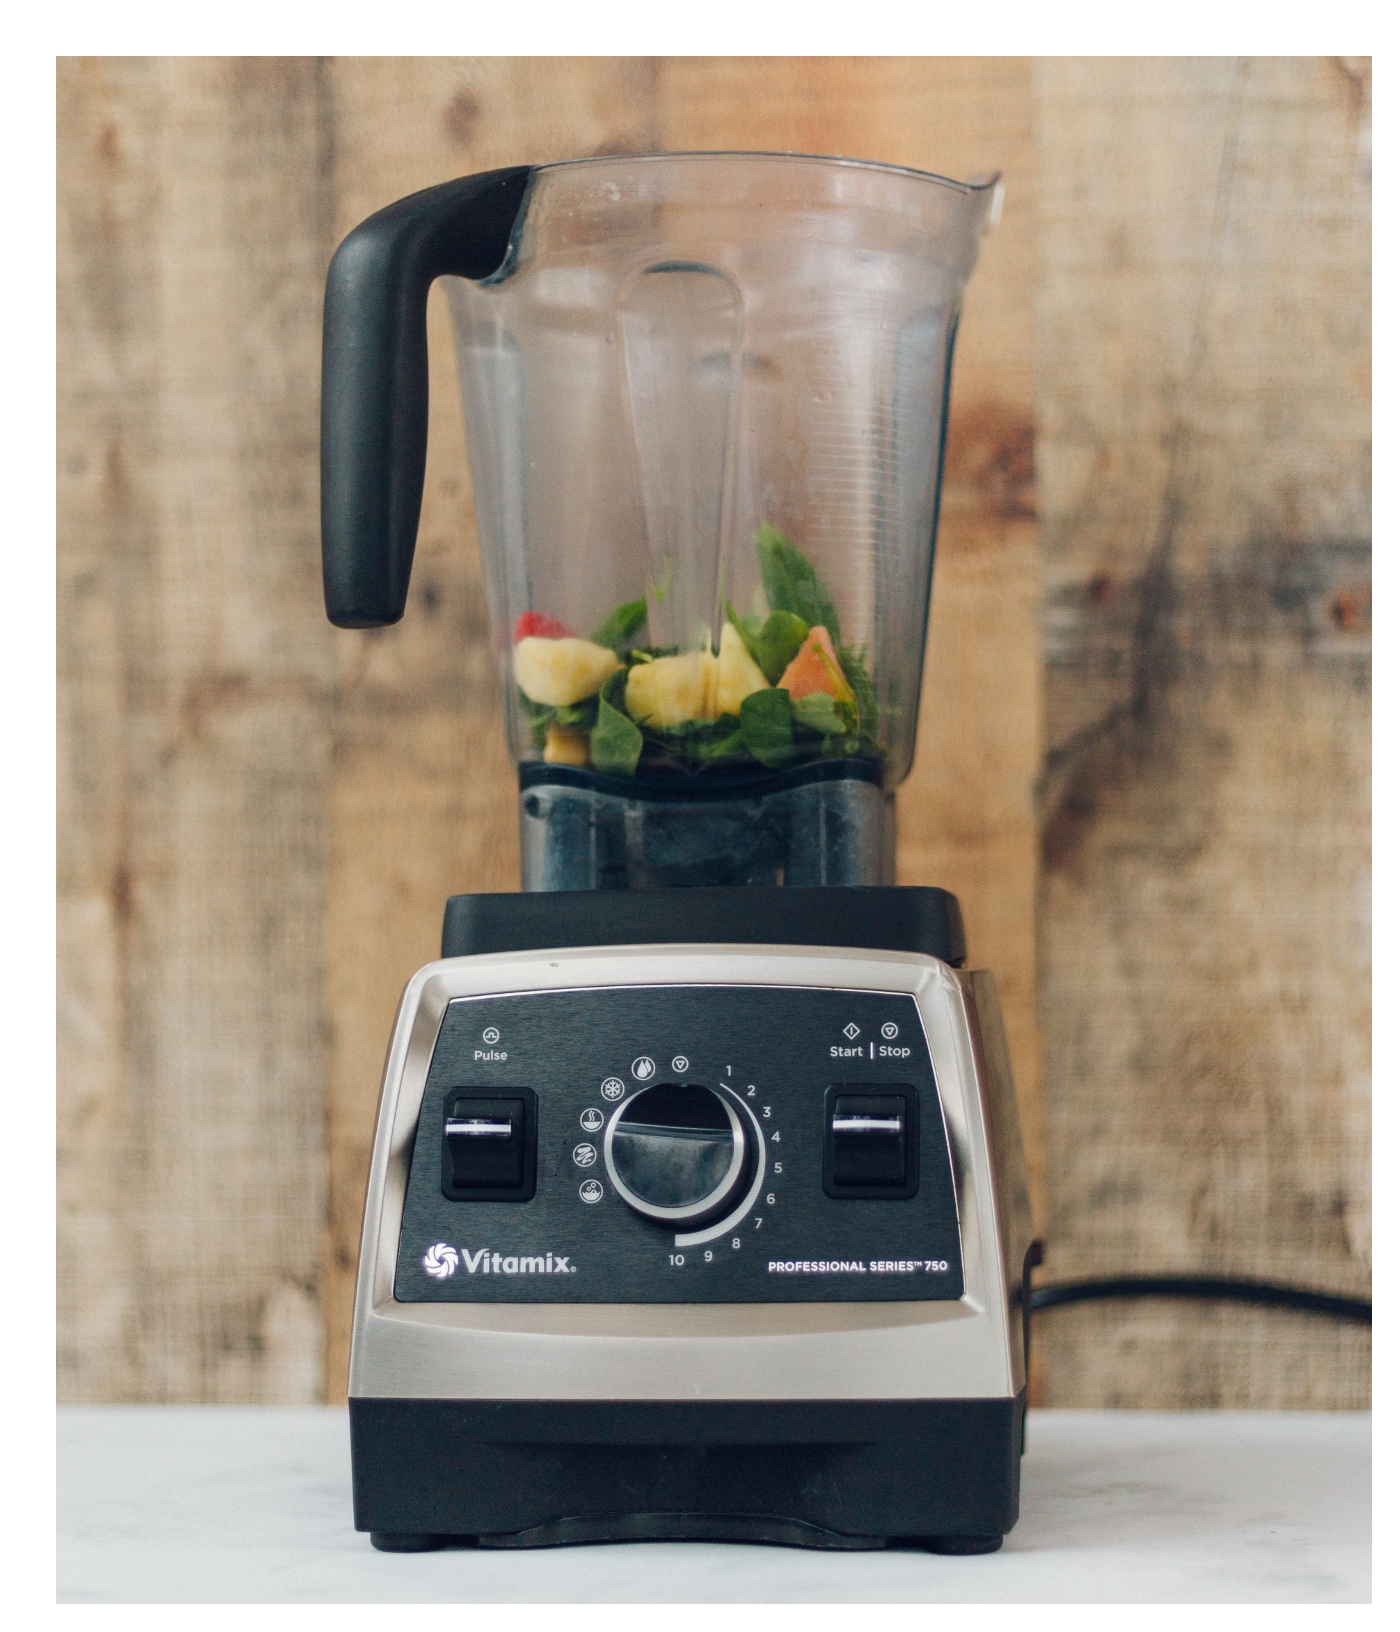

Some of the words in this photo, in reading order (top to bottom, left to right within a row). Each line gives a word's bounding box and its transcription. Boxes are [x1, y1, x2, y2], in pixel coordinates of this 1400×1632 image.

[474, 1049, 508, 1061] Pulse
[829, 1045, 864, 1057] Start
[878, 1045, 911, 1059] Stop
[746, 1084, 756, 1096] 2
[762, 1106, 771, 1118] 3
[771, 1131, 781, 1143] 4
[774, 1162, 783, 1174] 5
[766, 1192, 776, 1205] 6
[754, 1217, 763, 1229] 7
[731, 1237, 741, 1249] 8
[668, 1254, 685, 1266] 10
[704, 1250, 713, 1263] 9
[768, 1261, 867, 1272] PROFESSIONAL
[924, 1260, 948, 1272] 750
